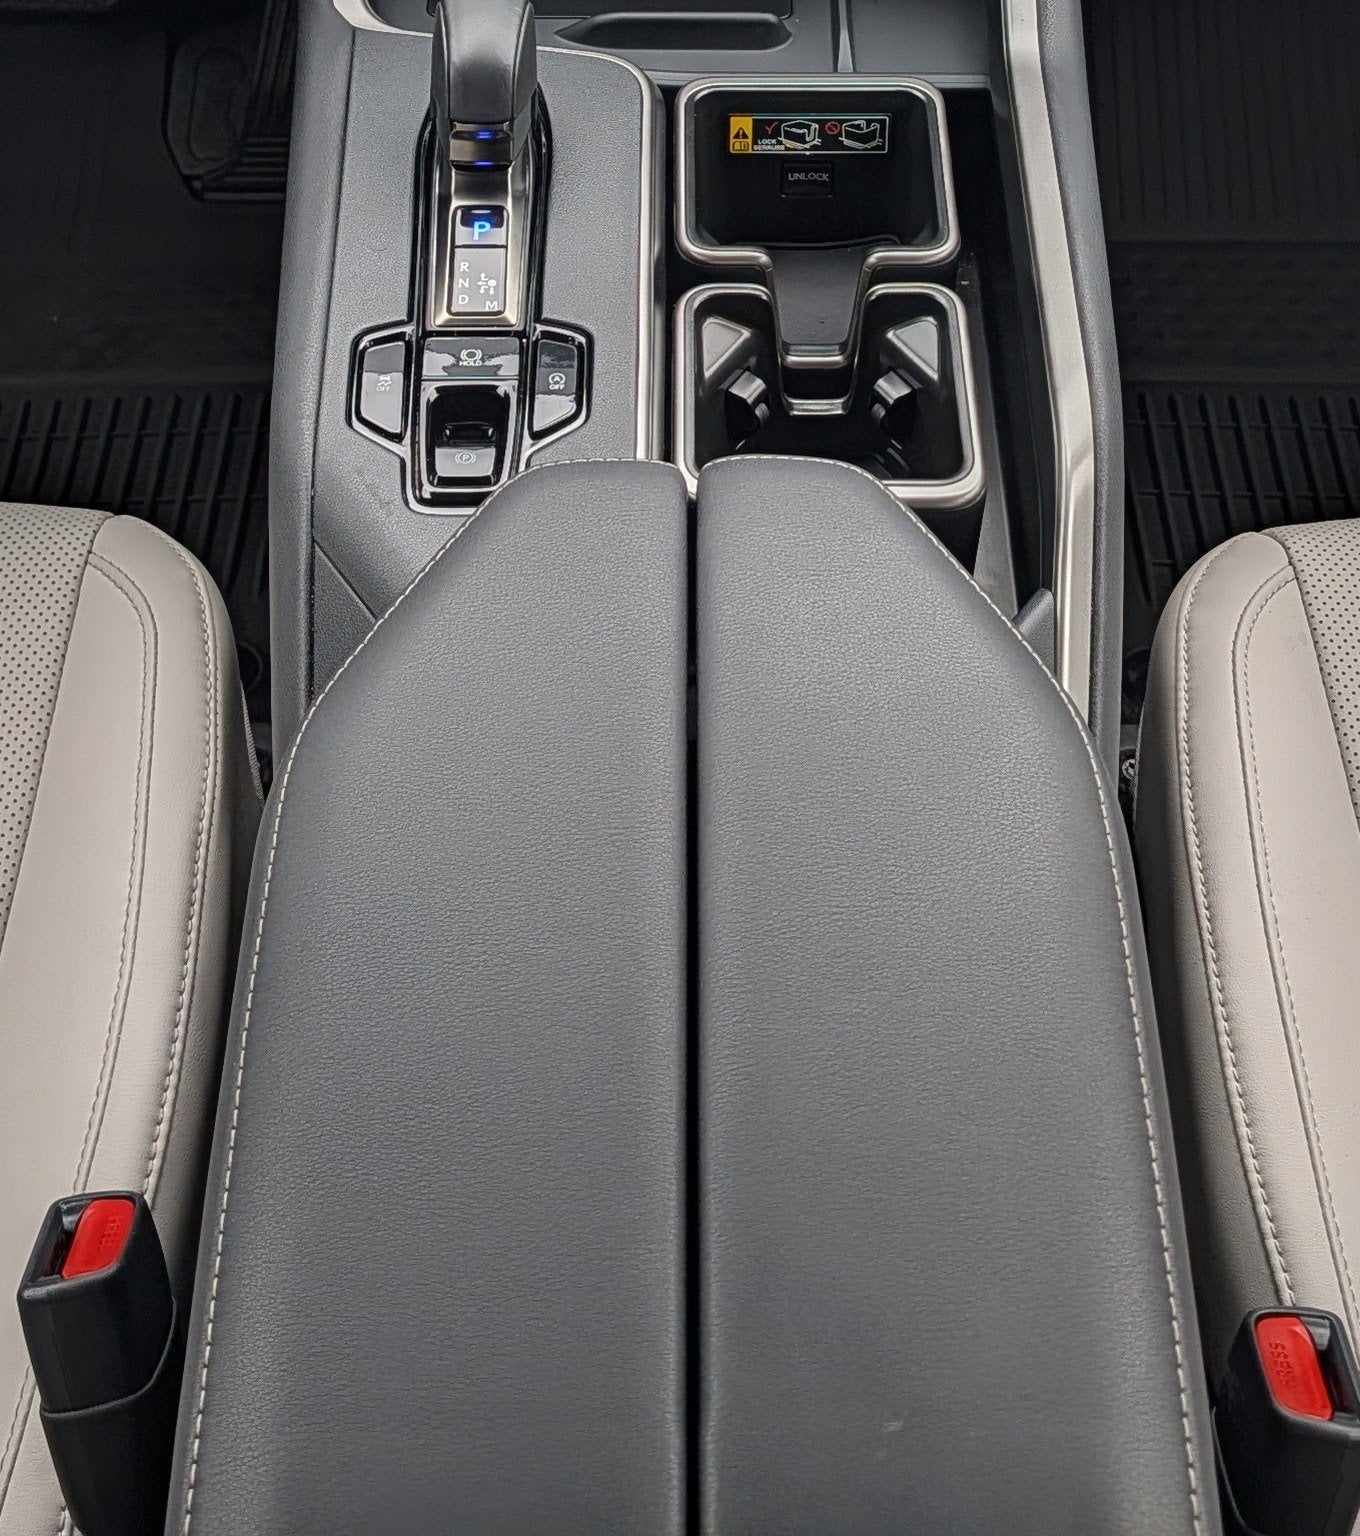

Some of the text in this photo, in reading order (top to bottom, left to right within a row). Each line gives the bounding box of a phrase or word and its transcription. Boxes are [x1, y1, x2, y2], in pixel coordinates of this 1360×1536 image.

[757, 138, 778, 146] LOCK
[787, 171, 830, 182] UNLOCK
[472, 221, 491, 241] P
[459, 261, 470, 273] R
[458, 277, 470, 288] N
[458, 294, 469, 305] D
[485, 300, 499, 312] M
[458, 359, 483, 367] HOLD
